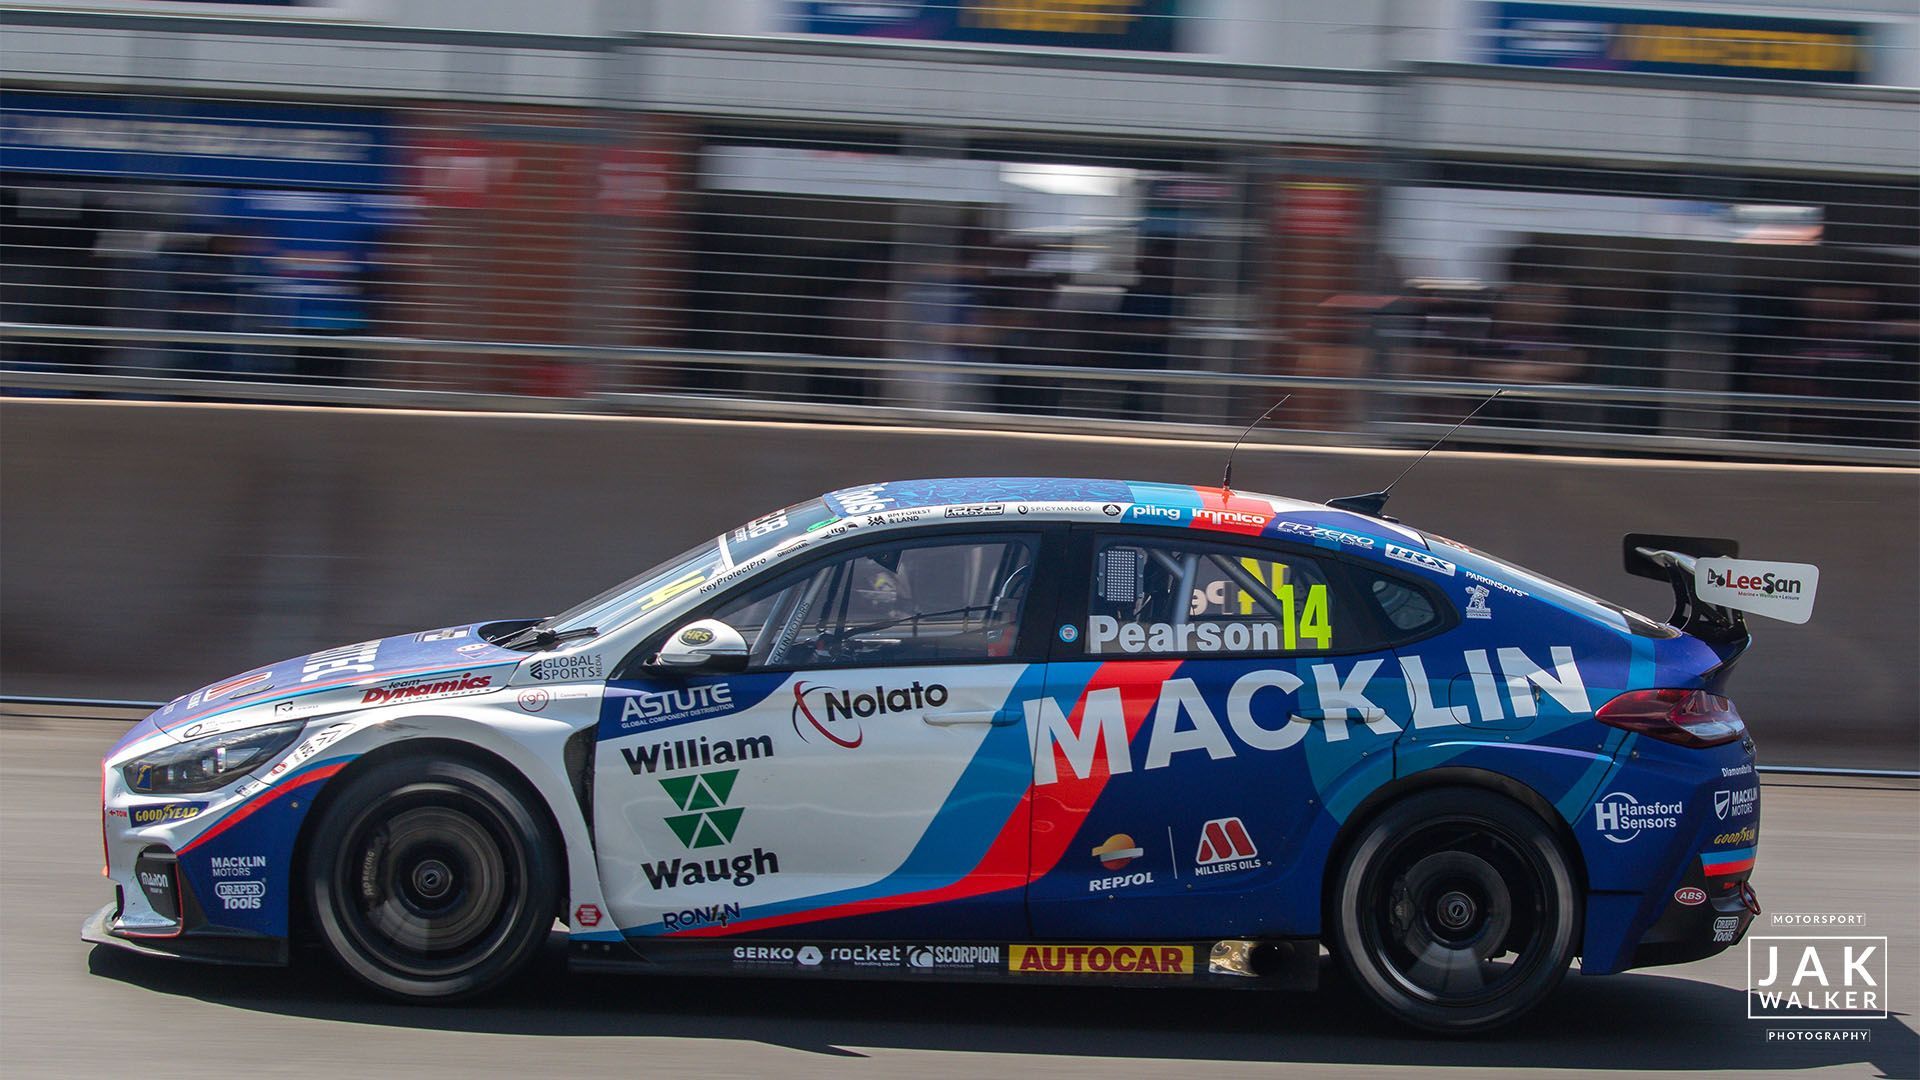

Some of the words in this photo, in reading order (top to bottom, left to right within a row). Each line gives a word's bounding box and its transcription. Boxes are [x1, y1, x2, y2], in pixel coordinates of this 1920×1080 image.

[896, 515, 920, 523] LAND
[699, 557, 767, 595] KeyProtectPro
[1725, 569, 1802, 595] LeeSan
[1277, 584, 1332, 650] 14
[684, 630, 712, 642] HRS
[1089, 615, 1279, 654] Pearson
[543, 655, 595, 669] GLOBAL
[543, 666, 595, 680] SPORTS
[360, 672, 493, 705] Dynamics
[387, 679, 420, 689] team
[621, 683, 733, 722] ASTUTE
[824, 681, 949, 722] Nolato
[621, 719, 649, 729] GLOBAL
[649, 711, 689, 724] COMPONENT
[690, 702, 735, 717] DISTRIBUTION
[1022, 645, 1592, 786] MACKLIN
[620, 733, 775, 776] William
[1619, 800, 1683, 816] Hansford
[1731, 802, 1753, 817] MOTORS
[1620, 816, 1677, 829] Sensors
[211, 856, 266, 868] MACKLIN
[641, 847, 780, 891] Waugh
[1195, 862, 1238, 877] MILLERS
[1239, 859, 1262, 871] OILS
[212, 867, 251, 877] MOTORS
[219, 884, 261, 895] DRAPER
[1088, 871, 1155, 892] REPSOL
[223, 895, 262, 910] Tools
[1680, 891, 1703, 901] ABS
[1713, 930, 1734, 942] Tools
[733, 946, 794, 960] GERKO
[830, 945, 901, 961] rocket
[935, 946, 1000, 964] SCORPION
[1019, 946, 1184, 973] AUTOCAR
